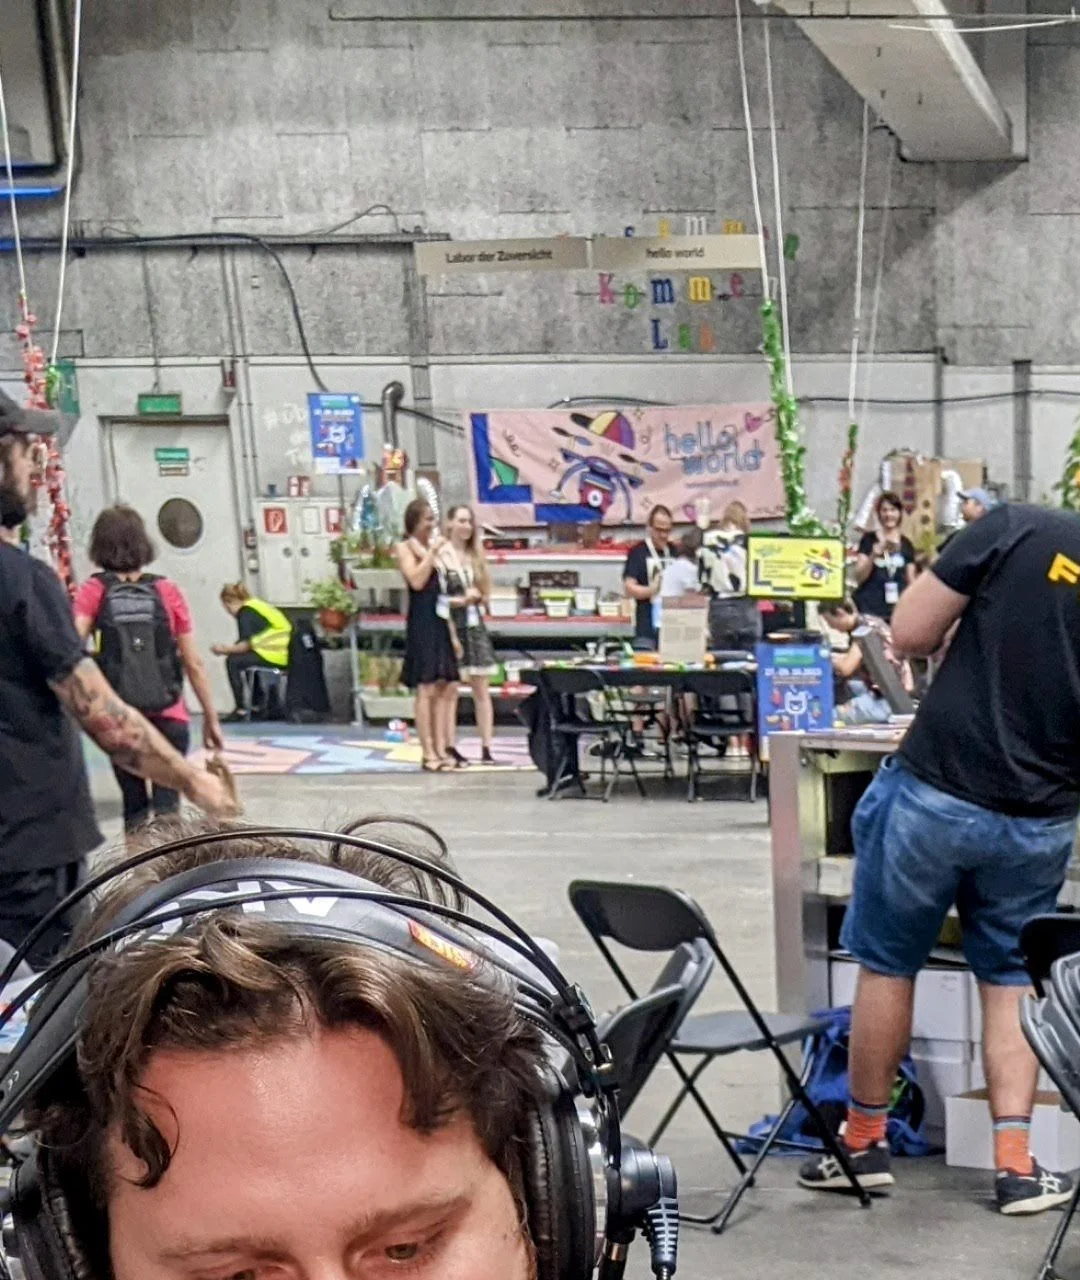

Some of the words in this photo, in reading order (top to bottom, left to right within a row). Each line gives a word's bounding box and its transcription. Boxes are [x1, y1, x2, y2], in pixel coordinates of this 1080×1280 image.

[446, 251, 475, 264] Labor
[477, 251, 497, 263] der
[498, 248, 553, 262] Zuversicht
[645, 247, 673, 259] hello
[675, 247, 705, 258] world
[663, 419, 738, 460] hello
[682, 439, 764, 475] world
